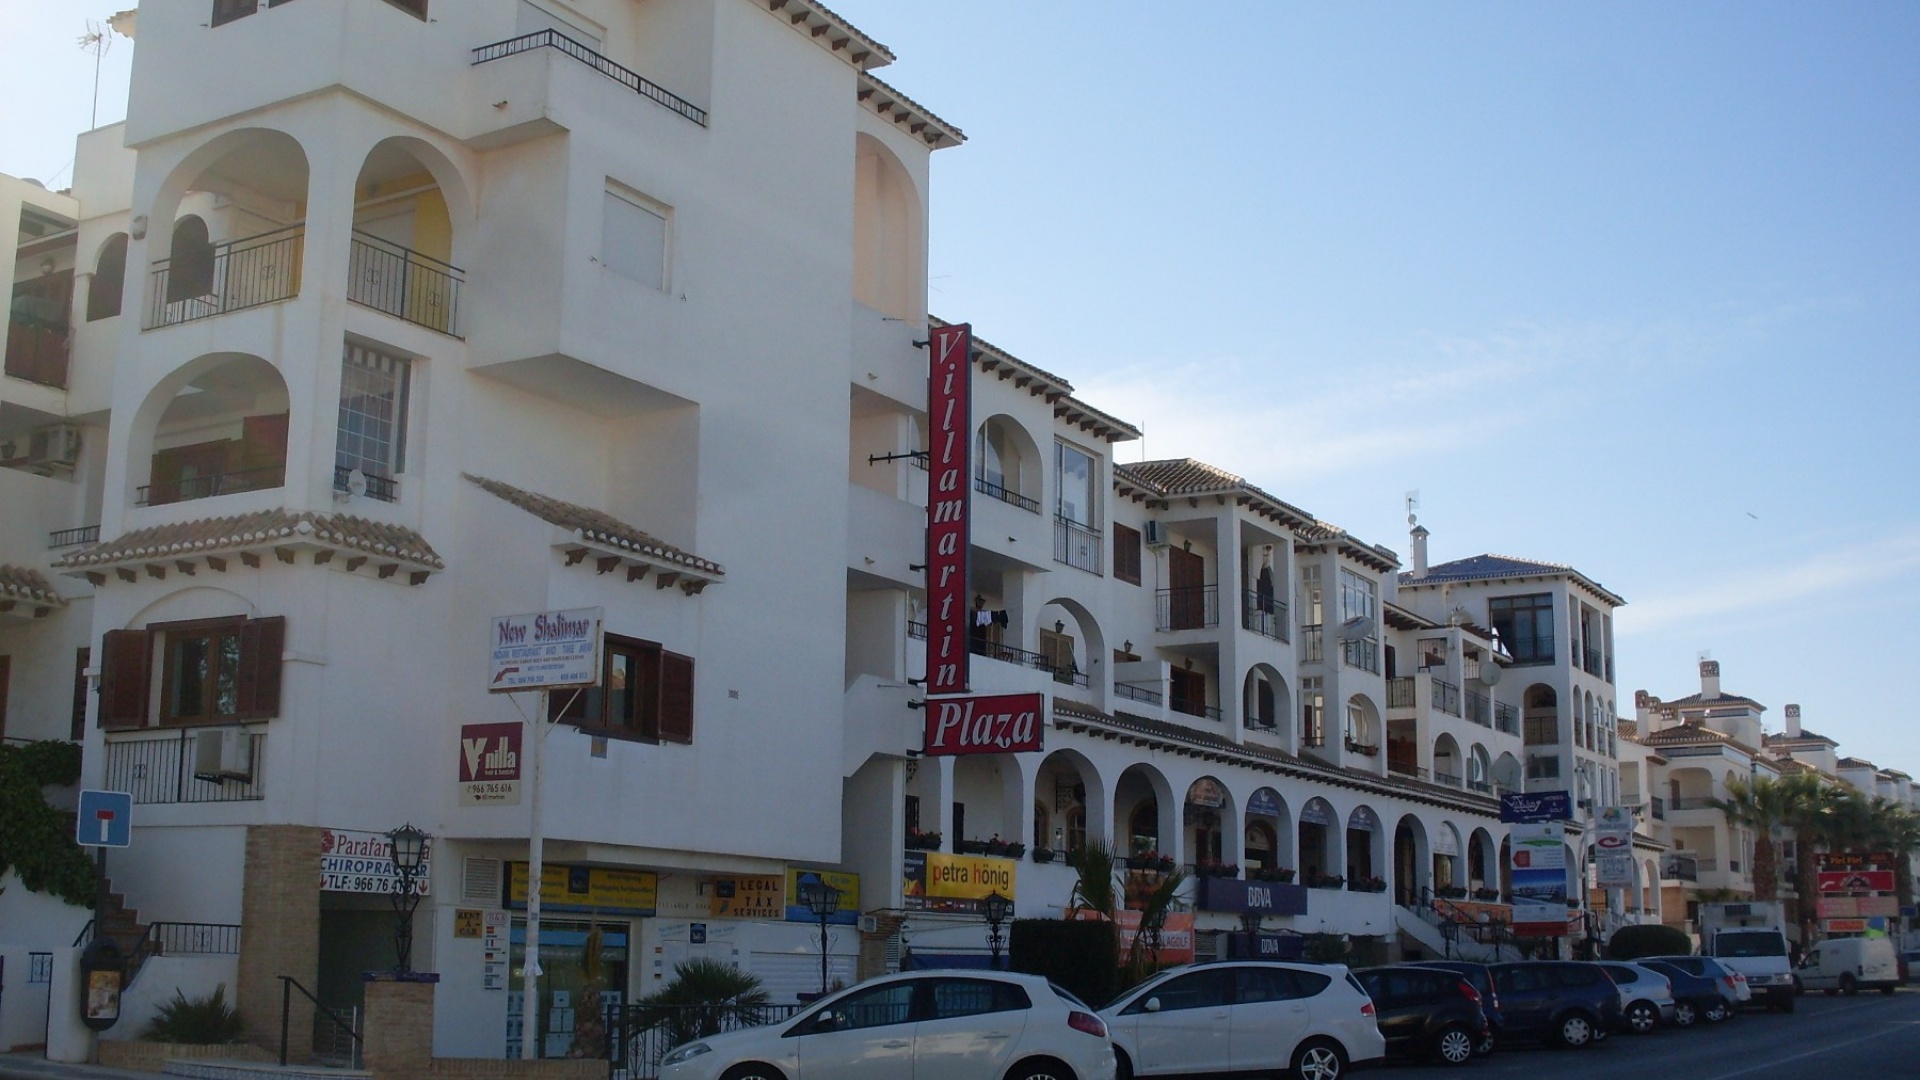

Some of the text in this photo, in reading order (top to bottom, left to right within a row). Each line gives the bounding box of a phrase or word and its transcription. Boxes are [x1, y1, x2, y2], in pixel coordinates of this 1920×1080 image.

[933, 331, 964, 687] Villamartin
[499, 612, 590, 646] New Shalimar
[932, 702, 1037, 749] Plaza
[473, 783, 512, 794] 966 765 616
[336, 834, 430, 861] Parafara
[328, 874, 352, 890] TLF:
[354, 877, 373, 891] 966
[376, 879, 389, 892] 76
[740, 879, 779, 892] LEGAL
[932, 862, 969, 886] petra
[973, 863, 1009, 891] hönig
[745, 896, 772, 907] TAX
[1247, 886, 1272, 908] BBVA
[458, 911, 481, 920] RENT
[734, 908, 779, 918] SERVICES
[1261, 938, 1279, 954] BBVA
